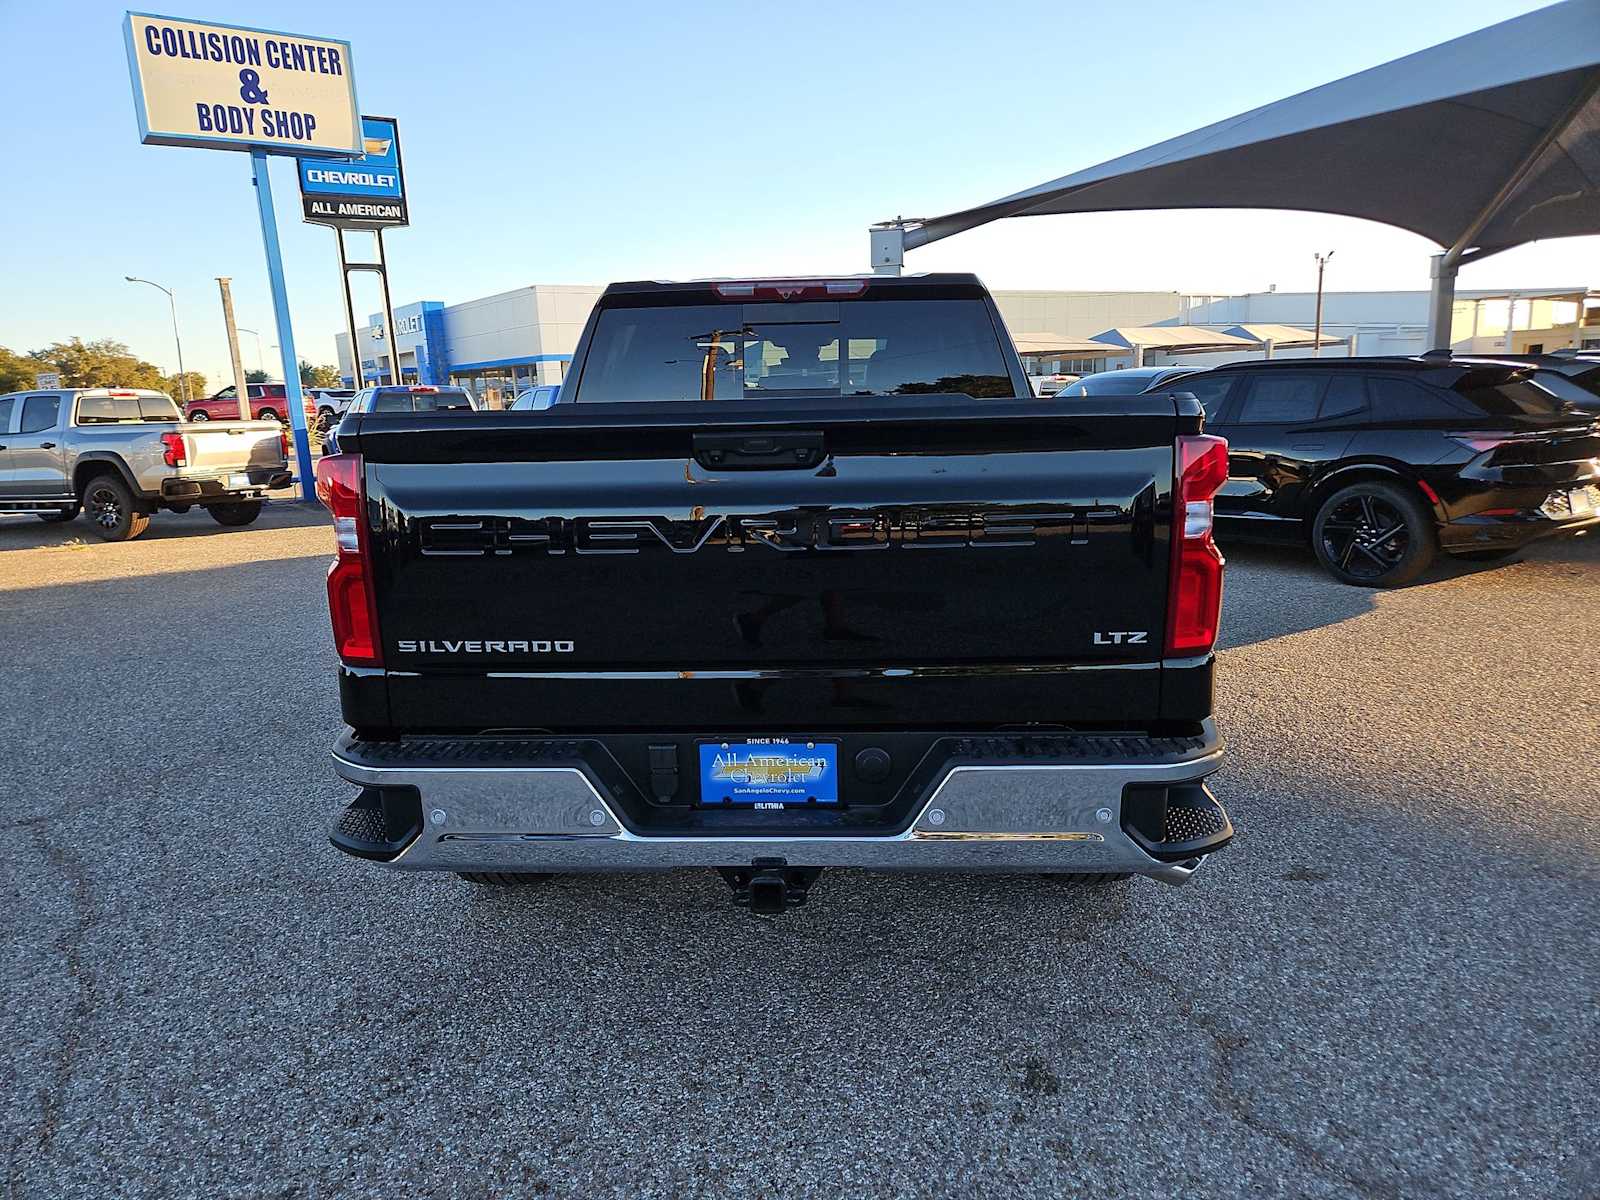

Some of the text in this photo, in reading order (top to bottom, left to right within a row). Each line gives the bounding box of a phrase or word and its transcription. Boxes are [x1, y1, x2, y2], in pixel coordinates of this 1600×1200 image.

[145, 25, 342, 76] COLLISION CENTER
[239, 68, 270, 105] &
[196, 103, 316, 141] BODY SHOP
[307, 169, 396, 188] CHEVROLET
[311, 201, 401, 218] ALL AMERICAN
[1093, 631, 1149, 645] LTZ
[397, 640, 576, 654] SILVERADO
[712, 752, 828, 768] All American
[730, 768, 806, 784] Chevrolet
[733, 787, 806, 796] SanAngeloChevy.com
